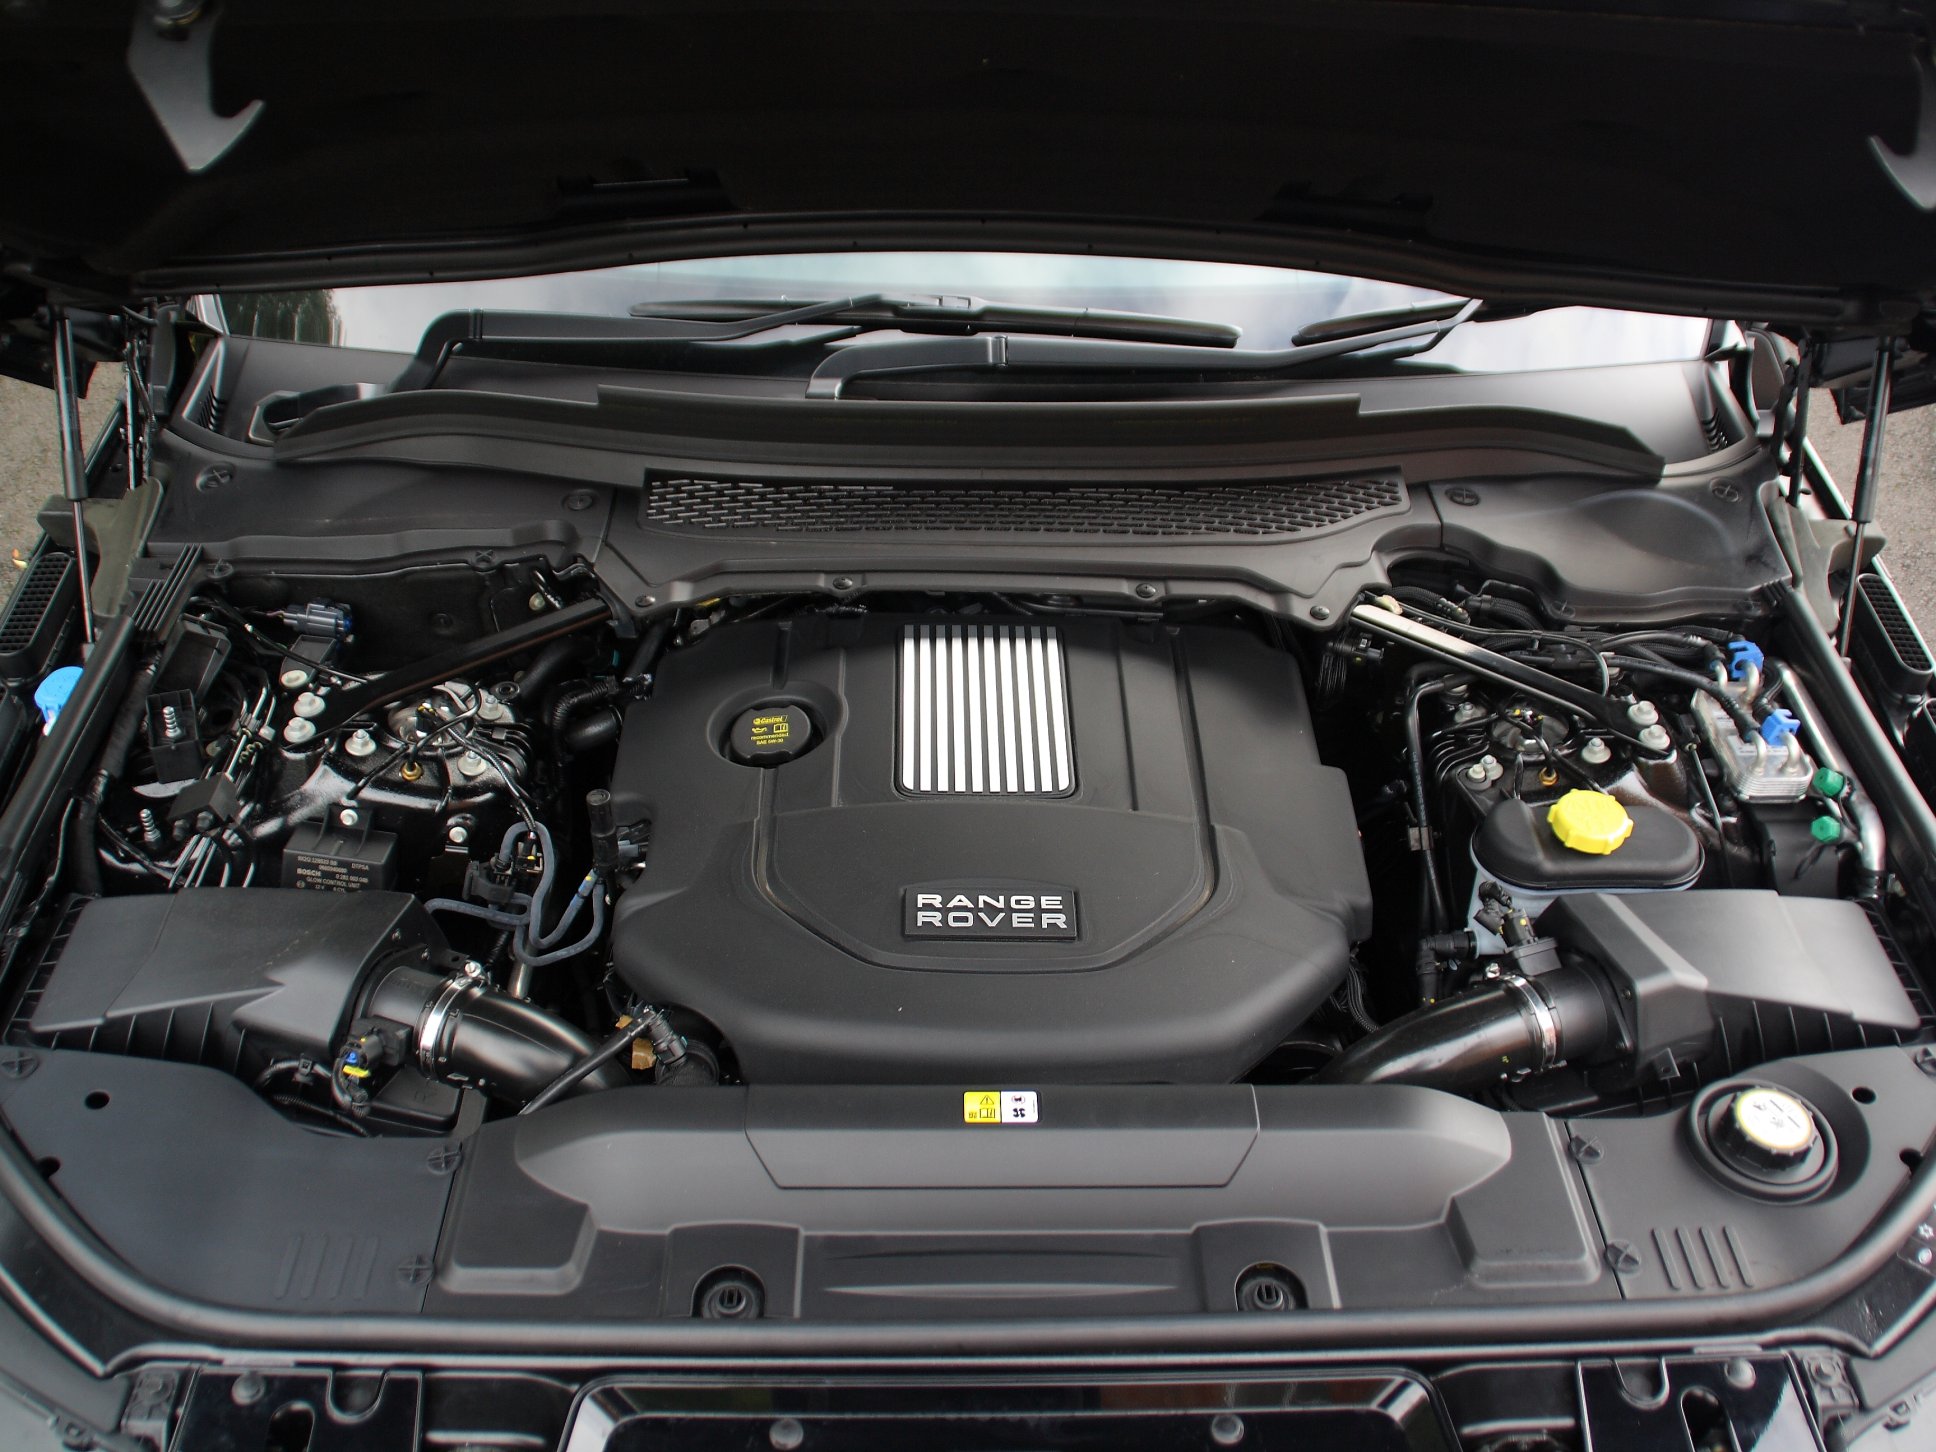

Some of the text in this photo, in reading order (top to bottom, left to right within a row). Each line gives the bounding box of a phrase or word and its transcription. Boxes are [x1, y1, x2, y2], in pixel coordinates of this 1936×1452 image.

[297, 868, 321, 877] BOSCH
[323, 879, 347, 887] CONTROL
[917, 894, 1063, 909] RANGE
[916, 911, 1068, 929] ROVER
